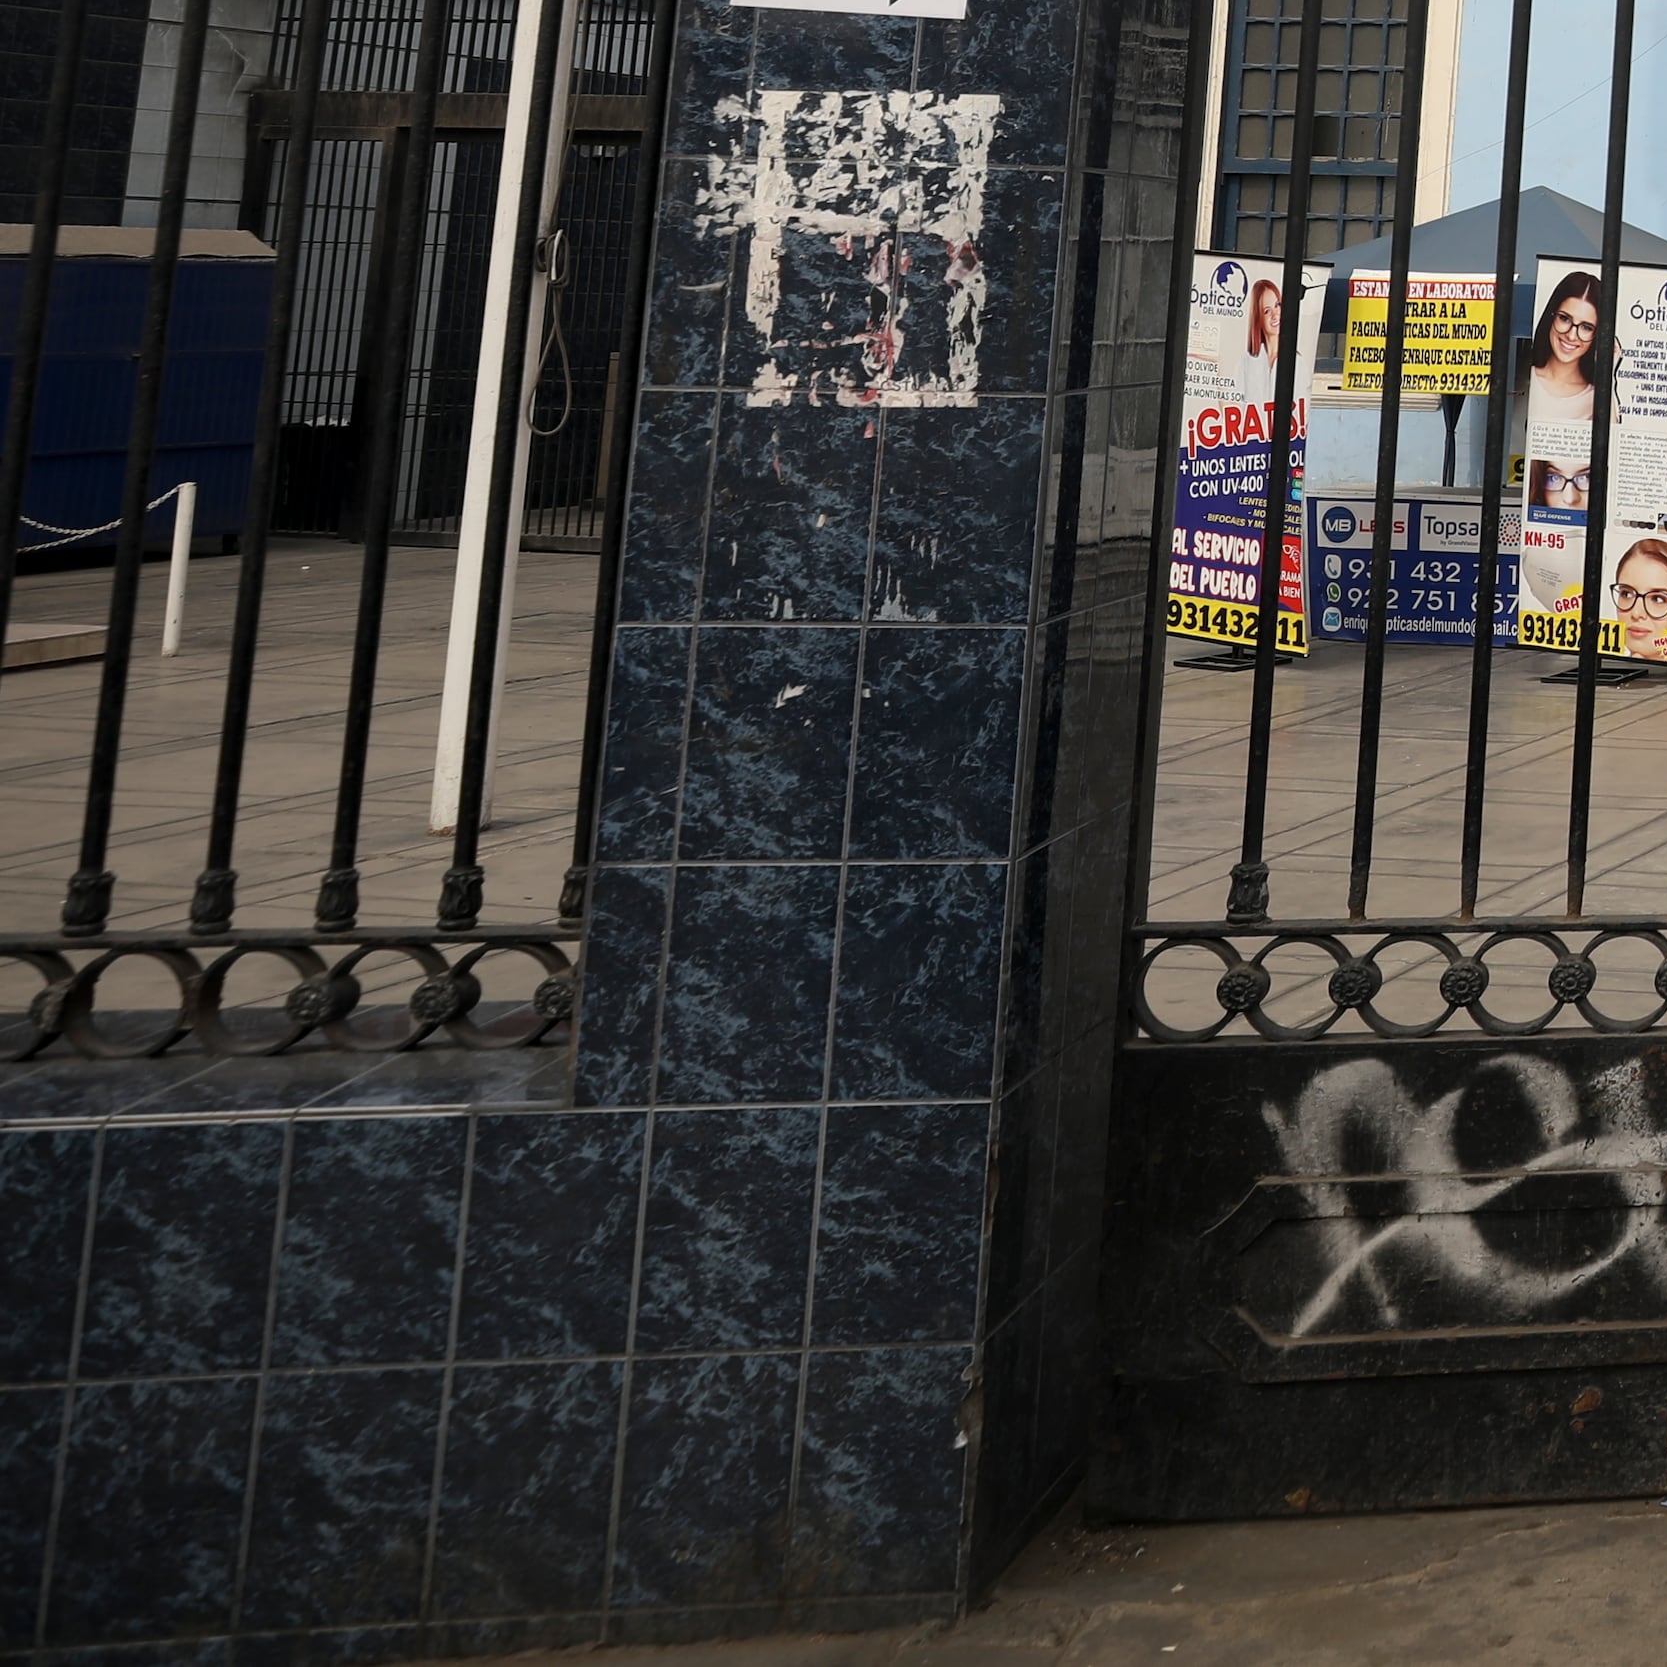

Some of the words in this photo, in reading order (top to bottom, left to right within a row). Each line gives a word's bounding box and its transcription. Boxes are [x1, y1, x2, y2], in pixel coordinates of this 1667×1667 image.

[1190, 284, 1244, 308] Ópticas
[1408, 283, 1426, 298] EN
[1427, 283, 1495, 300] LABORATOR
[1203, 306, 1215, 315] DEL
[1216, 307, 1244, 318] MUNDO
[1404, 302, 1436, 319] TRAR
[1439, 303, 1448, 319] A
[1450, 303, 1467, 319] LA
[1351, 321, 1387, 337] PAGINA
[1403, 322, 1431, 339] TICAS
[1432, 323, 1450, 339] DEL
[1452, 324, 1487, 340] MUNDO
[1650, 322, 1664, 332] DEL
[1350, 347, 1385, 364] FACEBO
[1402, 348, 1443, 366] ENRIQUE
[1444, 347, 1492, 366] CASTAÑE
[1194, 361, 1219, 373] OLVIDE
[1185, 373, 1201, 385] RAER
[1202, 375, 1211, 385] SU
[1211, 377, 1236, 388] RECETA
[1348, 372, 1384, 389] TELEFO
[1440, 373, 1490, 392] 9314327
[1184, 387, 1193, 397] AS
[1194, 388, 1229, 401] MONTURAS
[1187, 397, 1307, 459] ¡GRATS!
[1192, 458, 1226, 478] UNOS
[1230, 454, 1267, 473] LENTES
[1189, 480, 1219, 498] CON
[1222, 475, 1264, 495] UV-400
[1239, 497, 1268, 507] LENTES
[1248, 518, 1252, 526] Y
[1325, 518, 1352, 532] MB
[1359, 519, 1405, 534] LES
[1424, 515, 1479, 539] Topsa
[1172, 528, 1189, 556] AL
[1193, 530, 1260, 566] SERVICIO
[1524, 531, 1565, 550] KN-95
[1410, 560, 1461, 583] 432
[1169, 562, 1196, 592] DEL
[1199, 566, 1257, 602] PUEBLO
[1411, 589, 1456, 611] 751
[1554, 594, 1584, 614] GRAT
[1166, 599, 1306, 648] 93143211
